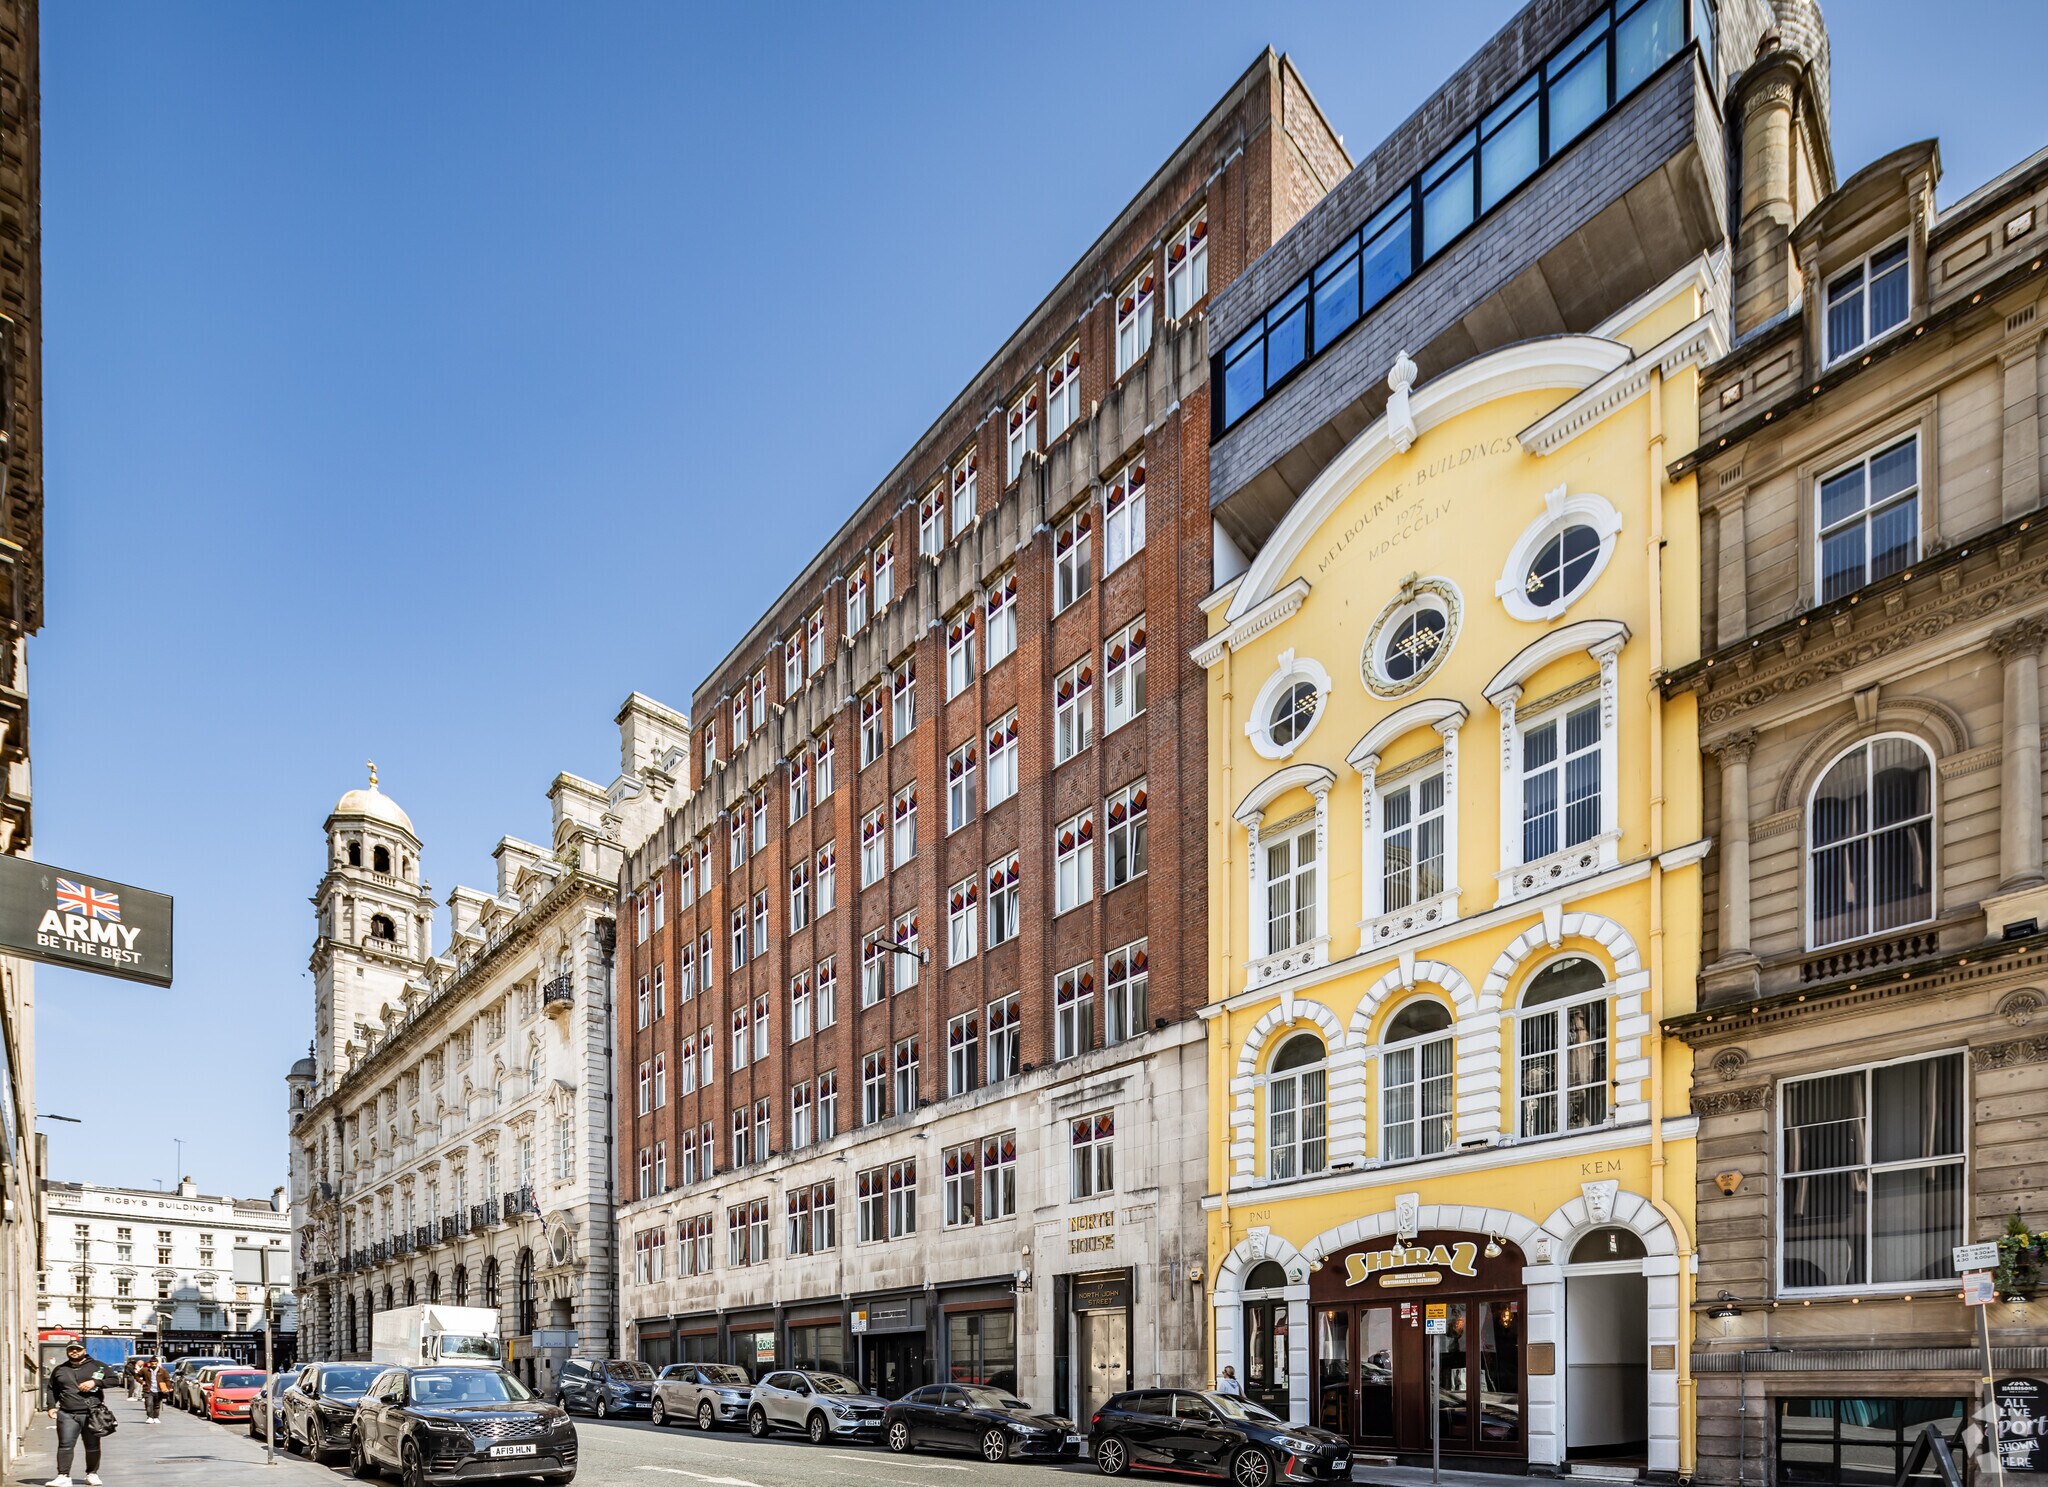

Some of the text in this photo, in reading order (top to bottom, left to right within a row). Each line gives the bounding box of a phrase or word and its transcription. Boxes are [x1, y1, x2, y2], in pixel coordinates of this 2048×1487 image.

[1318, 436, 1516, 573] MELBOURNE BUILDINGS
[1396, 499, 1425, 526] 1975
[1368, 500, 1451, 562] MDCCCLIV
[37, 909, 141, 950] ARMY
[37, 933, 142, 964] BE THE BEST
[1581, 1159, 1621, 1176] KEM
[104, 1196, 214, 1212] RIGBY'S BUILDINGS
[1068, 1210, 1114, 1233] NORTH
[1250, 1210, 1271, 1222] PNU
[1068, 1234, 1115, 1255] HOUSE
[1345, 1241, 1477, 1287] SHIRAZ
[1079, 1291, 1100, 1299] NORTH
[1088, 1298, 1112, 1306] STREET
[757, 1340, 775, 1350] CORE
[2004, 1398, 2028, 1408] ALL
[2000, 1408, 2032, 1417] LIVE
[1985, 1415, 2048, 1438] port
[495, 1446, 532, 1456] AF19 HLN
[1998, 1440, 2040, 1453] SHOWN
[2001, 1456, 2034, 1468] HERE
